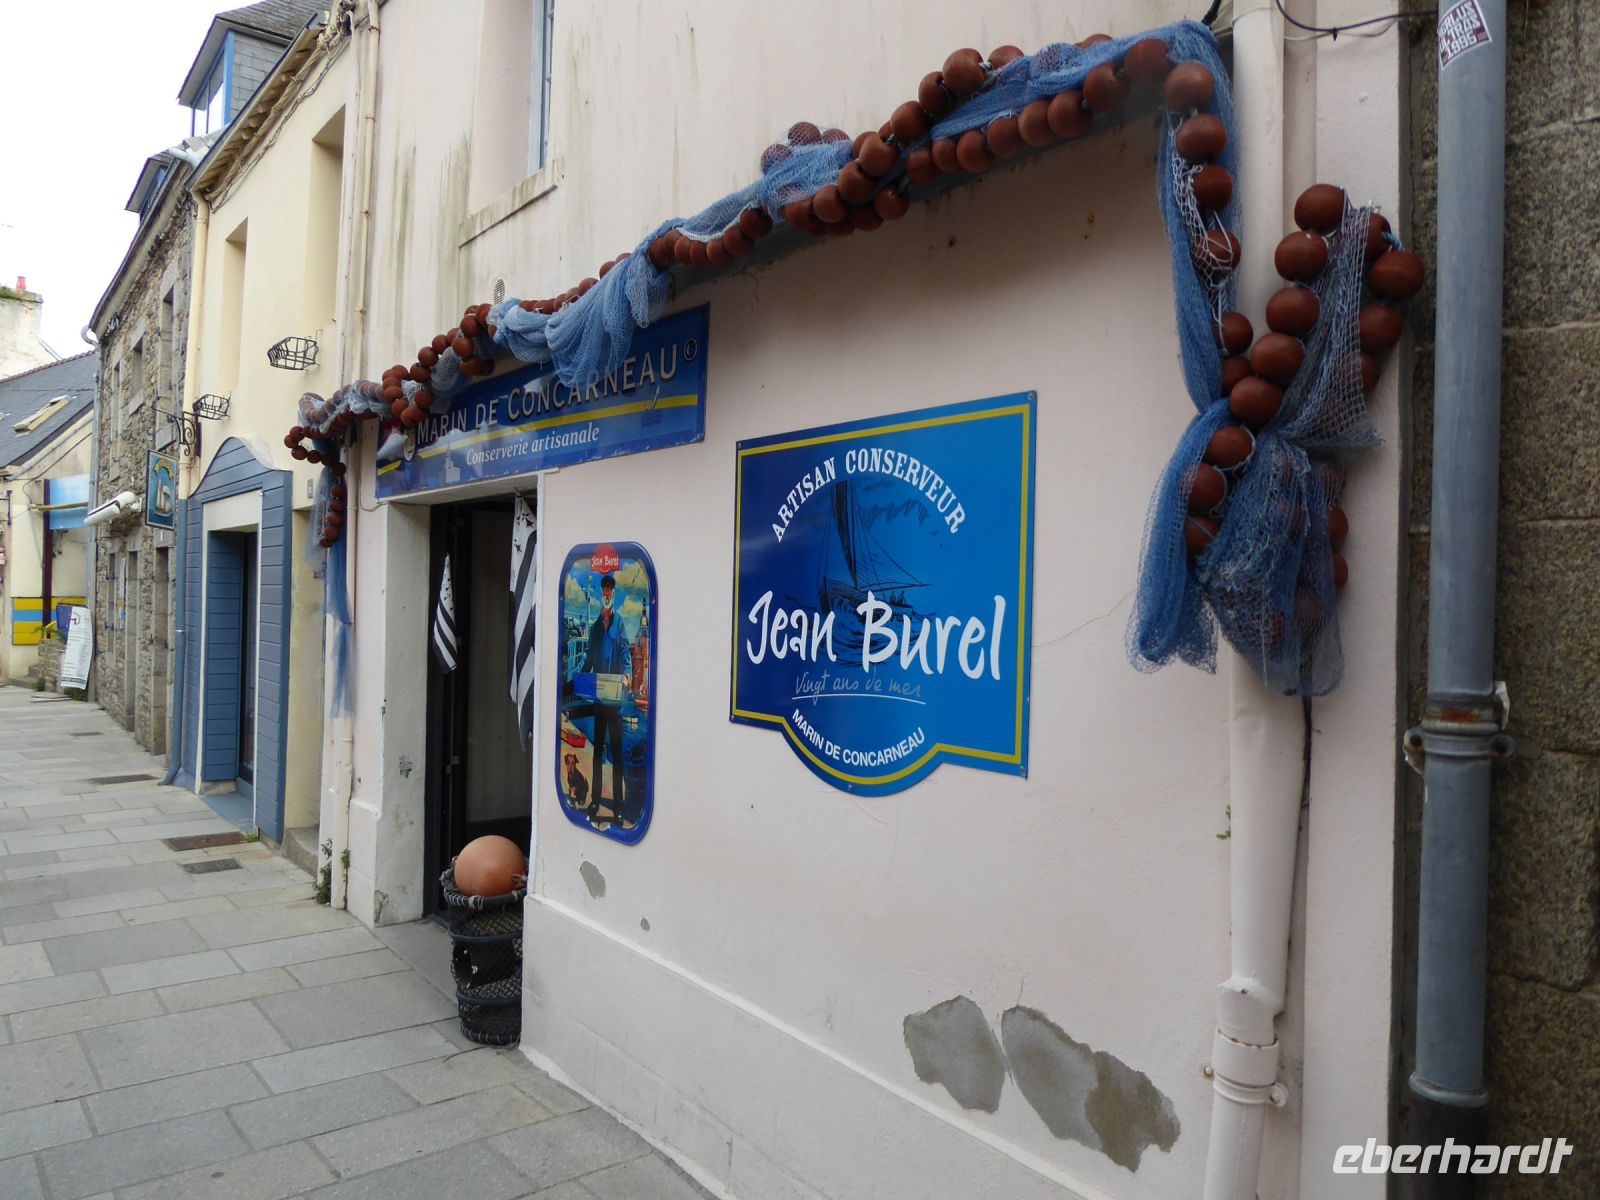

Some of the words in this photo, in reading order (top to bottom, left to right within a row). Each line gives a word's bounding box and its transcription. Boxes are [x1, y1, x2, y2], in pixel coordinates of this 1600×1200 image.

[1438, 1, 1477, 36] ERLUS
[1447, 33, 1477, 59] 1995
[417, 407, 467, 445] MARIN
[475, 399, 498, 429] DE
[507, 344, 677, 420] CONCARNEAU
[466, 437, 528, 465] Conserverie
[531, 422, 599, 453] artisanale
[771, 456, 837, 543] ARTISAN
[845, 447, 966, 534] CONSERVEUR
[747, 590, 837, 664] Jean
[856, 590, 1006, 680] Burel
[795, 668, 831, 706] Vingt
[833, 677, 859, 692] ans
[866, 668, 883, 692] de
[791, 708, 824, 750] MARIN
[824, 739, 841, 761] DE
[842, 727, 926, 767] CONCARNEAU
